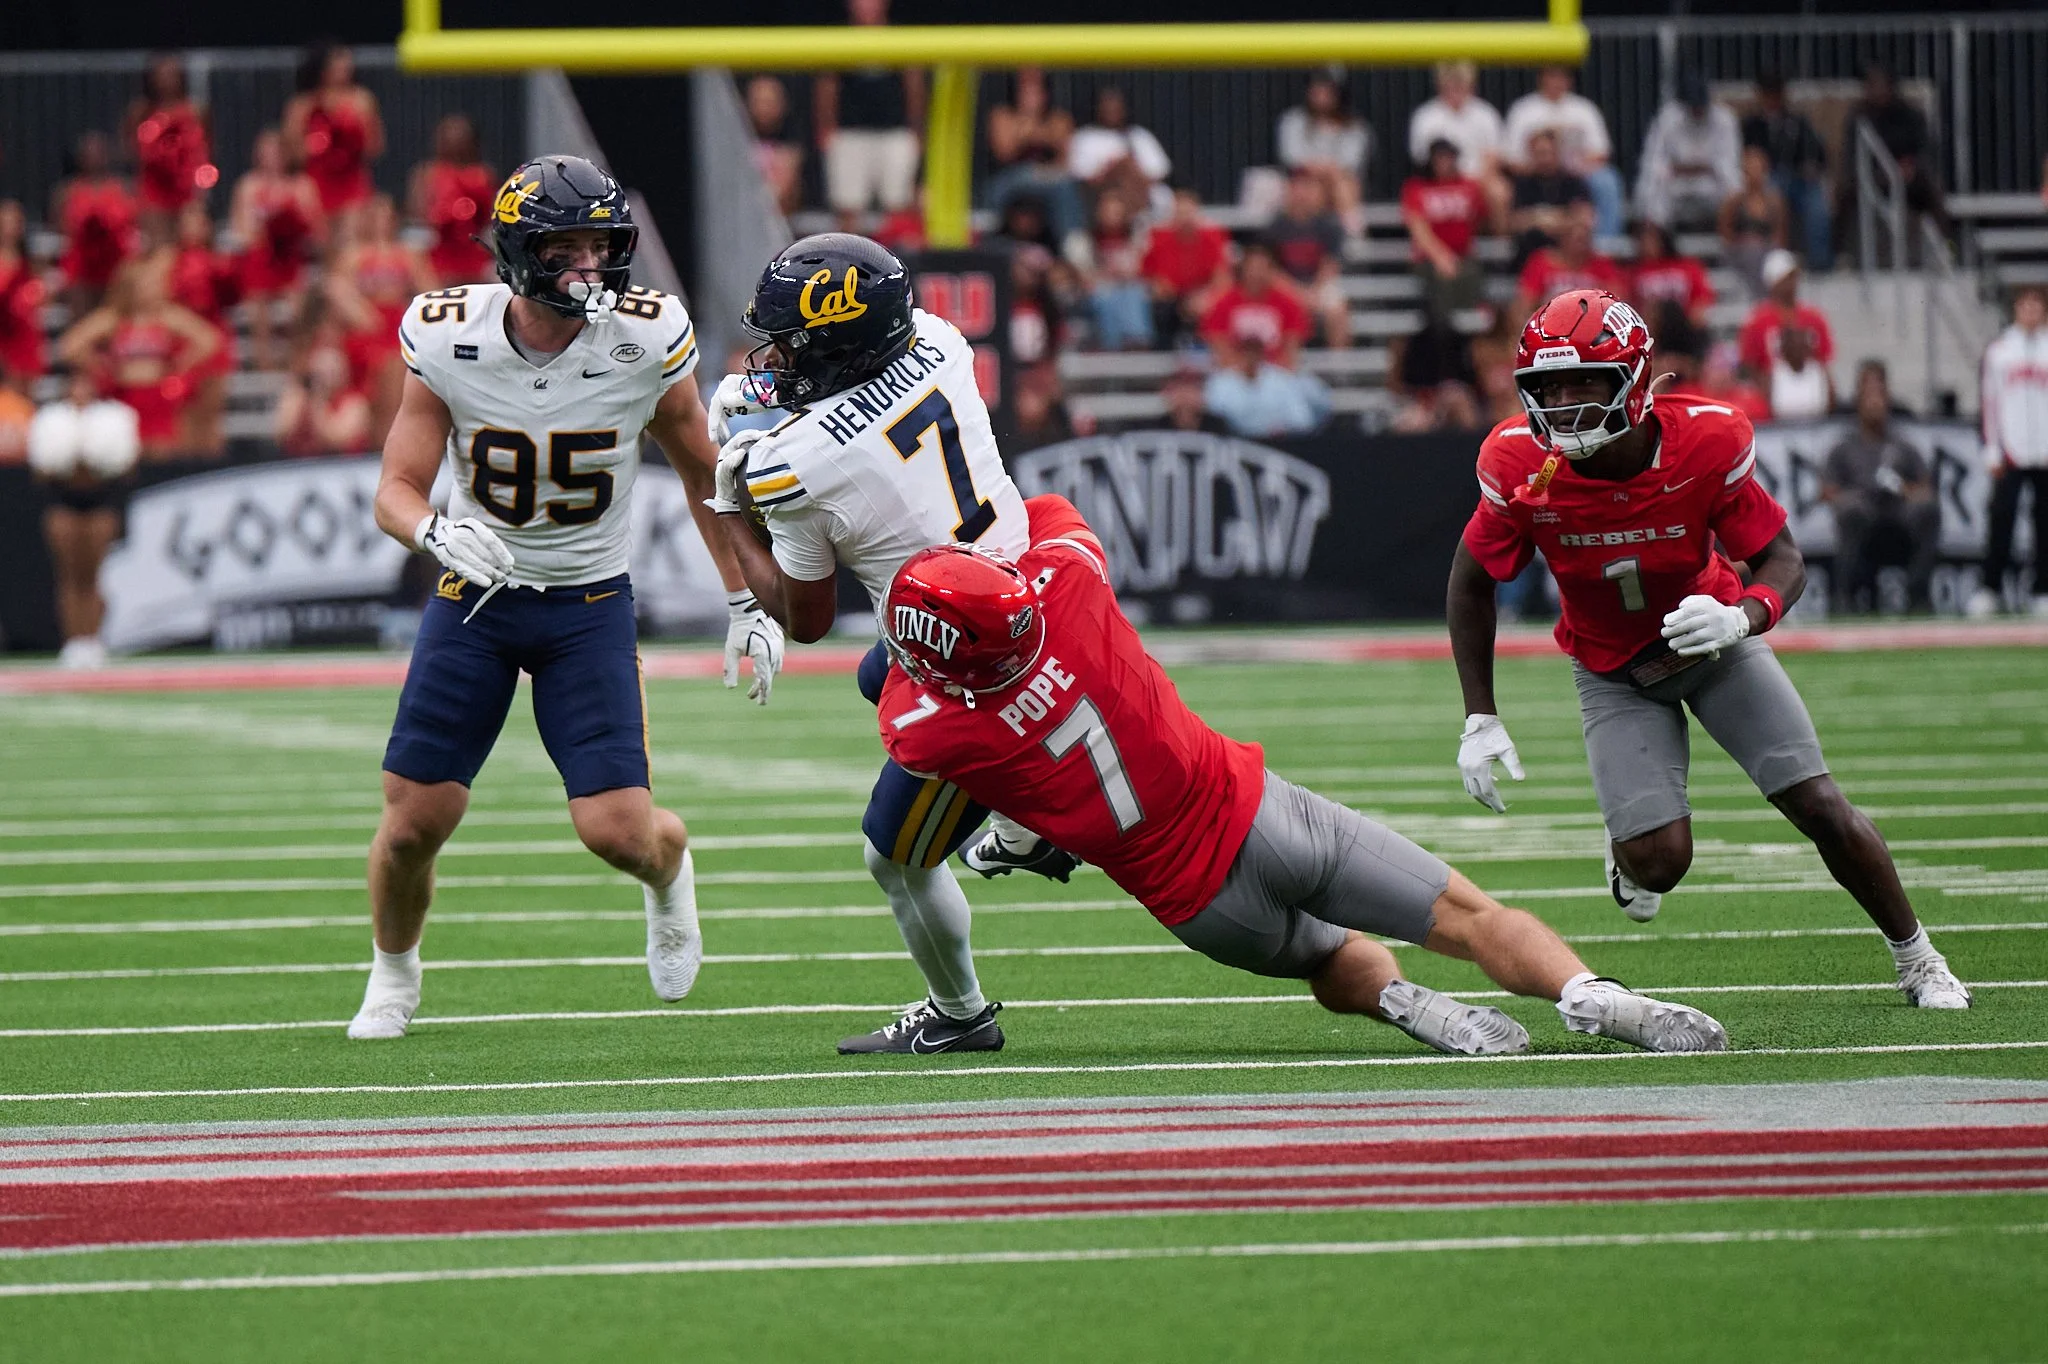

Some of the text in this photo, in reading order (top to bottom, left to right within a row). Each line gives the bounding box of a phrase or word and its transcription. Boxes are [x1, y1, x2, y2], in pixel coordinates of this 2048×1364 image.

[491, 173, 540, 224] Cal
[799, 265, 868, 329] Cal
[616, 346, 639, 356] ACC
[1538, 350, 1574, 360] VEGAS
[533, 377, 548, 390] Cal
[818, 337, 946, 446] HENDRICKS
[470, 425, 618, 528] 85
[882, 383, 998, 543] 7
[1559, 524, 1686, 546] REBELS
[436, 571, 467, 600] Cal
[1601, 554, 1646, 613] 1
[894, 605, 961, 660] UNLV
[997, 655, 1076, 737] POPE
[1040, 692, 1146, 837] 7
